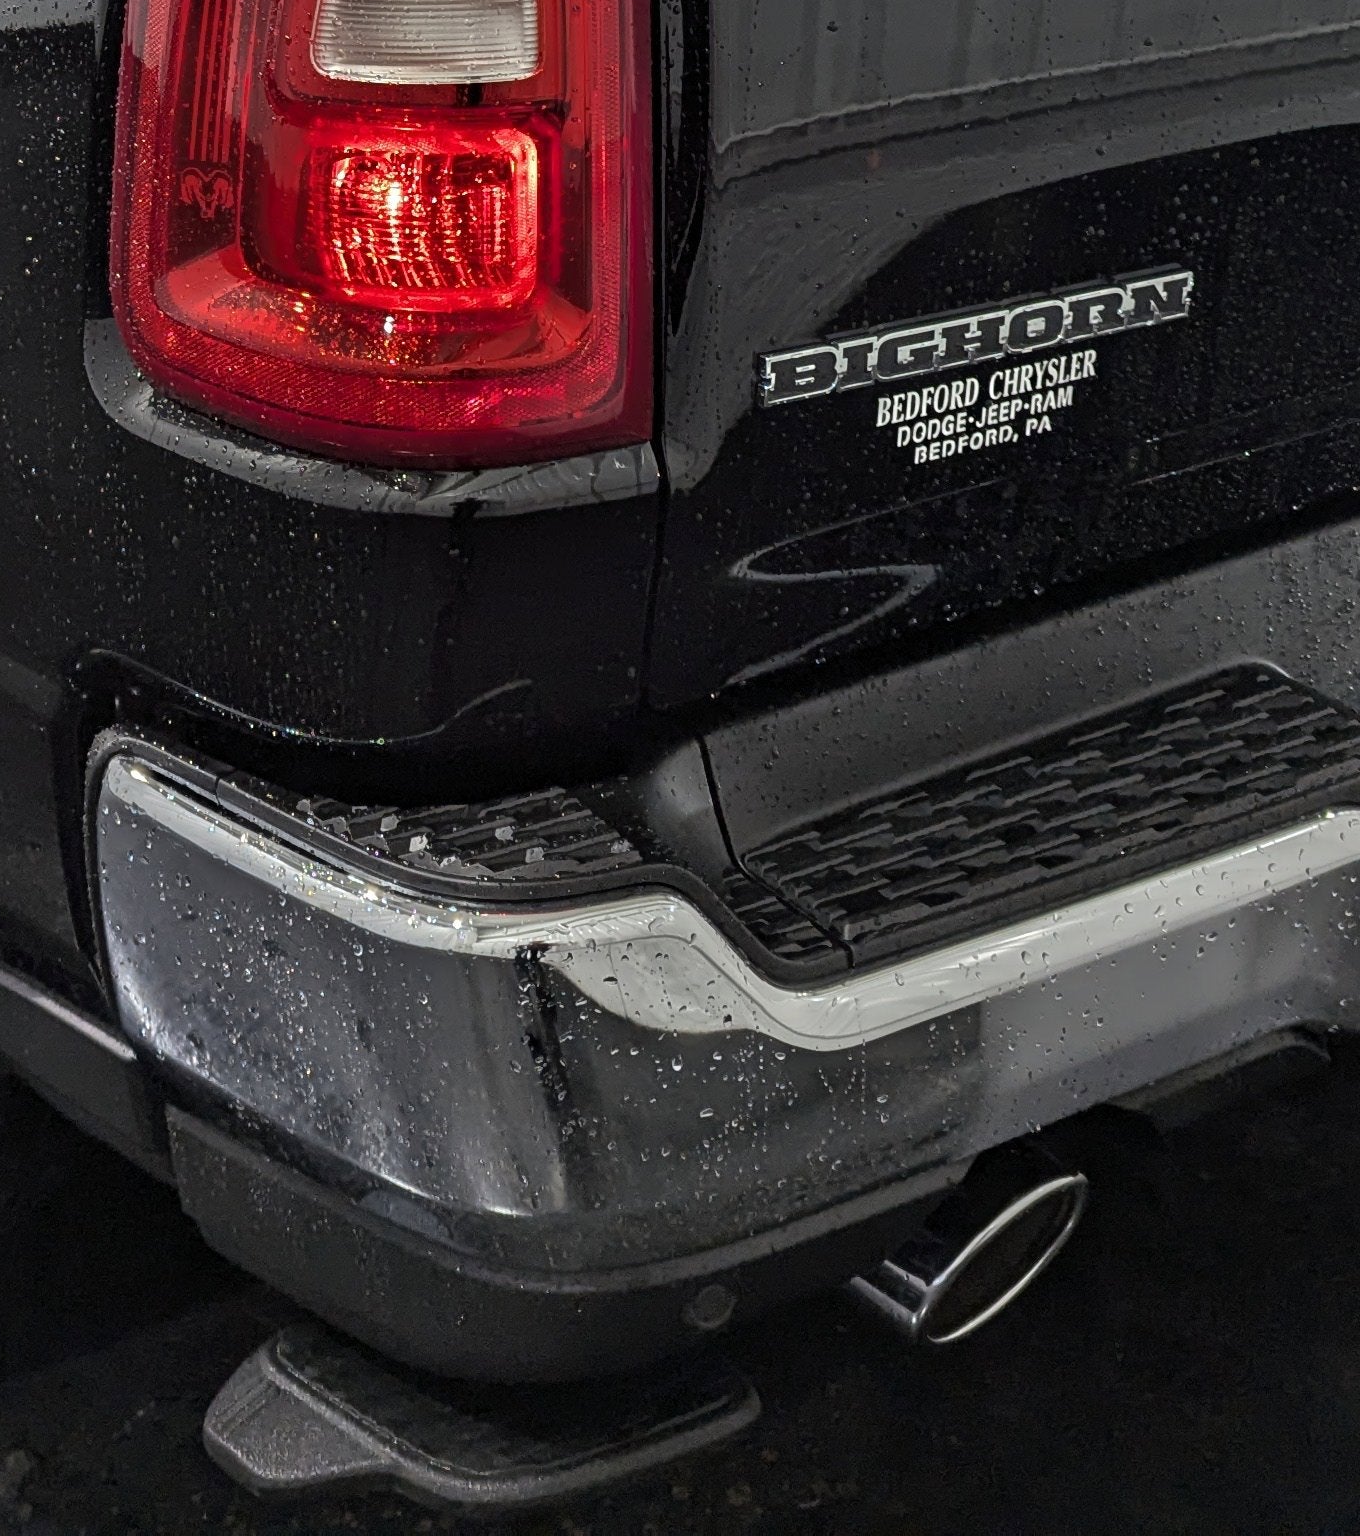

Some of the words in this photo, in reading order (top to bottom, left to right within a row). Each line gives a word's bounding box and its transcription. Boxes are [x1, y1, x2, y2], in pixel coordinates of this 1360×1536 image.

[875, 376, 980, 428] BEDFORD
[988, 349, 1098, 401] CHRYSLER
[914, 428, 1019, 465] BEDFORD,
[1025, 414, 1053, 436] PA
